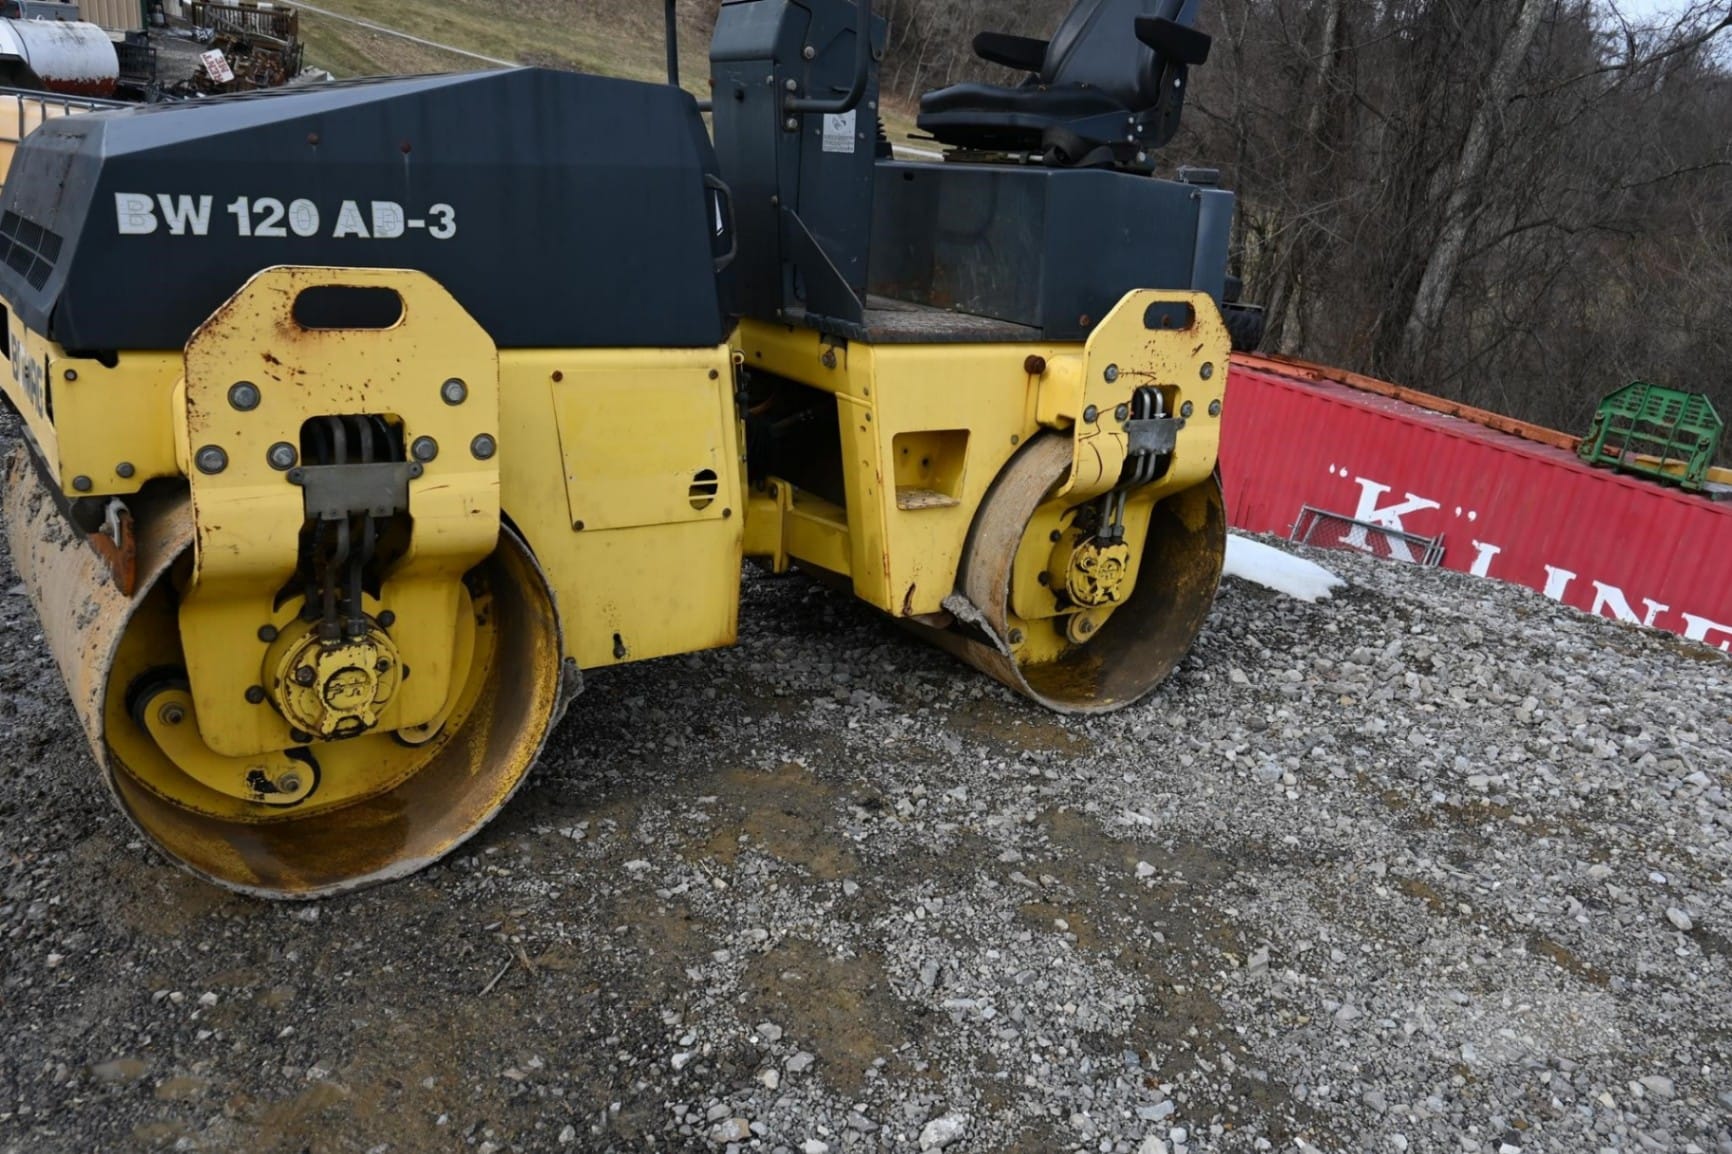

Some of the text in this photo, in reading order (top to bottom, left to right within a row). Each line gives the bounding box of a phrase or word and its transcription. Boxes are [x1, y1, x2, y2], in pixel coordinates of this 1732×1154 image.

[114, 192, 457, 239] BW 120 AD-3
